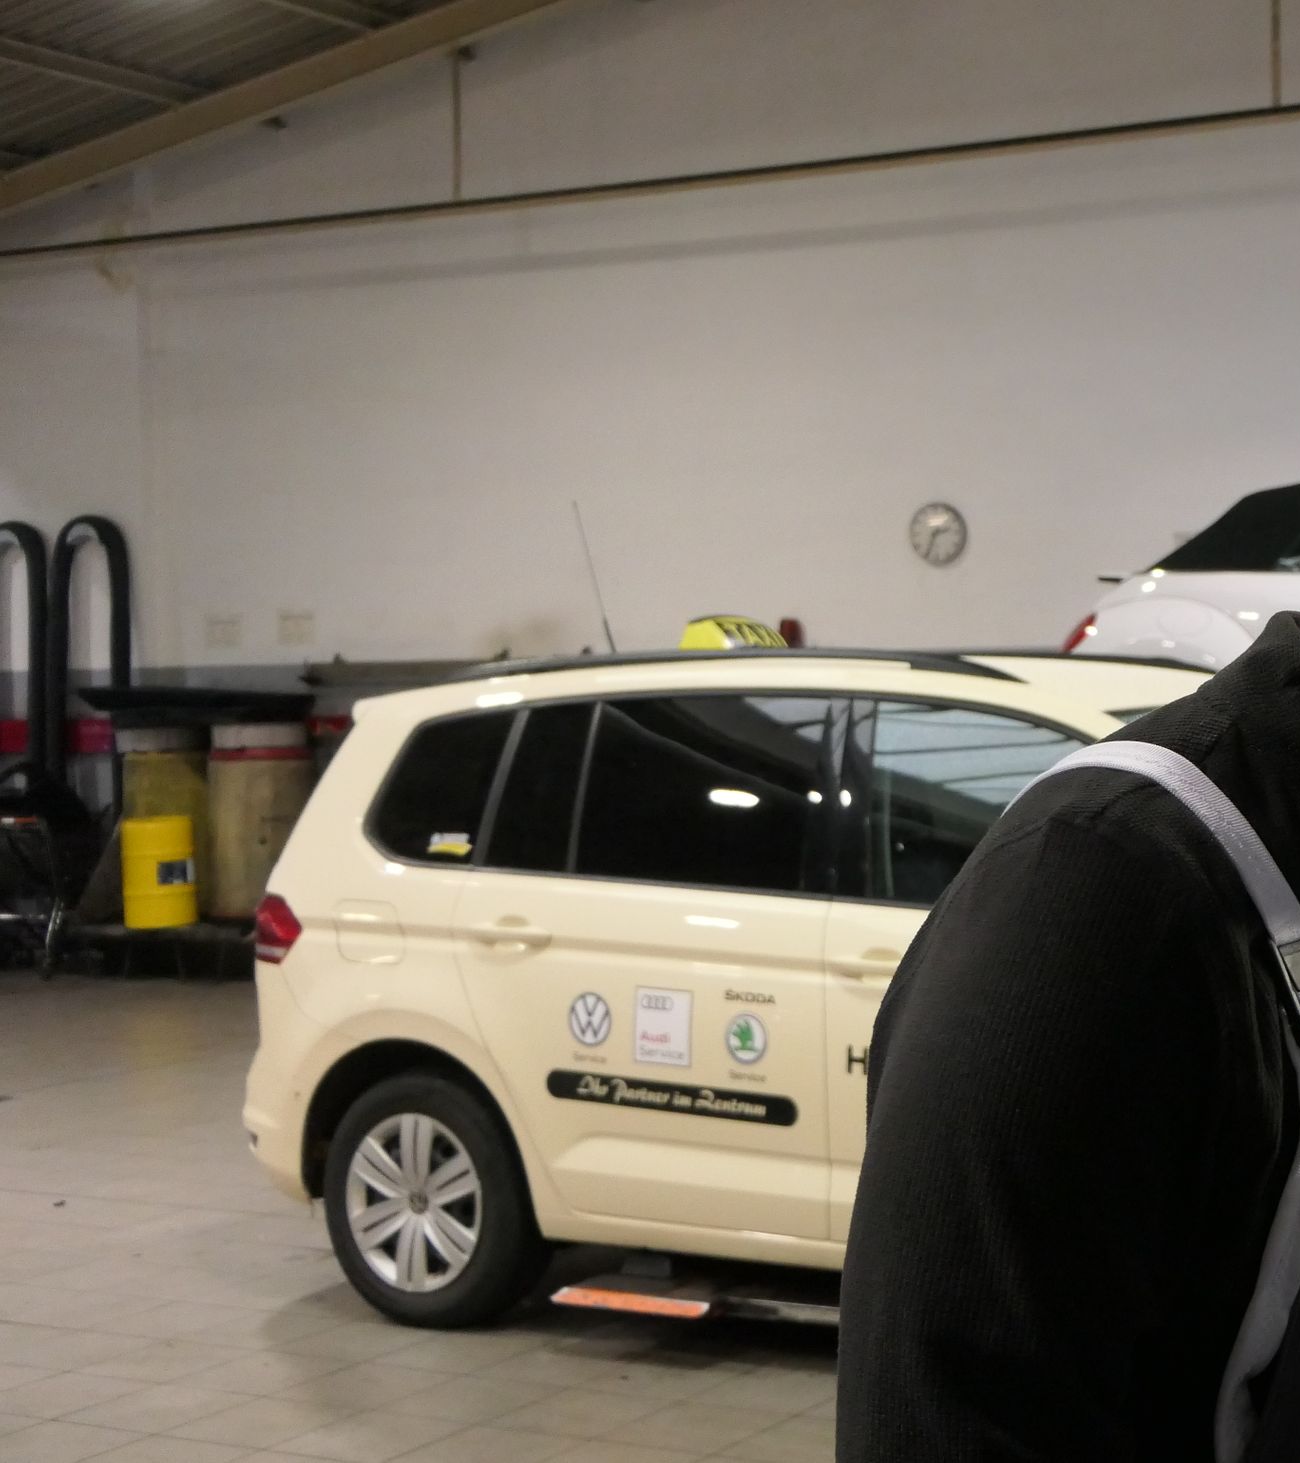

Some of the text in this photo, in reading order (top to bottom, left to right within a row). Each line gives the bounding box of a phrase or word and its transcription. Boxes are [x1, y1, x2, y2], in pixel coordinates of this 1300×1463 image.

[640, 1030, 671, 1044] Audi
[610, 1078, 670, 1104] Partner
[671, 1090, 693, 1107] im
[694, 1088, 767, 1117] Zentrum
